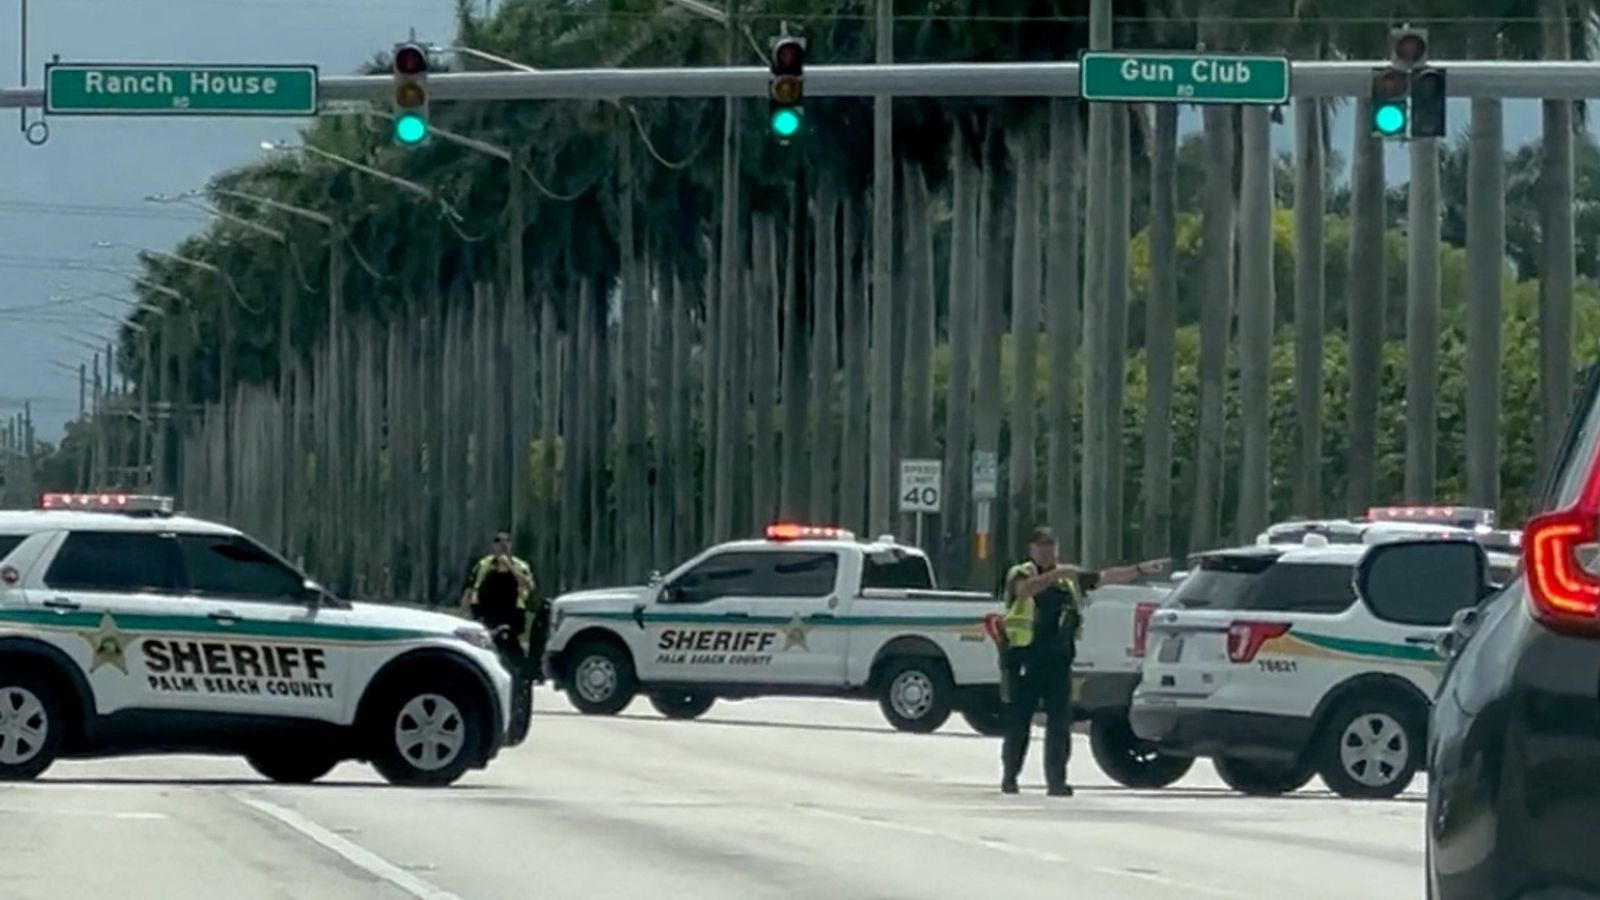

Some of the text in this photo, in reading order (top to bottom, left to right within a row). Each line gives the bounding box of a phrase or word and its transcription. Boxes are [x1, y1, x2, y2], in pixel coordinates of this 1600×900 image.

[85, 71, 278, 95] Ranch House
[1121, 59, 1251, 83] Gun Club
[904, 487, 937, 505] 40
[658, 629, 776, 651] SHERIFF
[141, 639, 327, 679] SHERIFF
[656, 653, 773, 666] PALM BEACH COUNTY
[148, 675, 334, 699] PALM BEACH COUNTY
